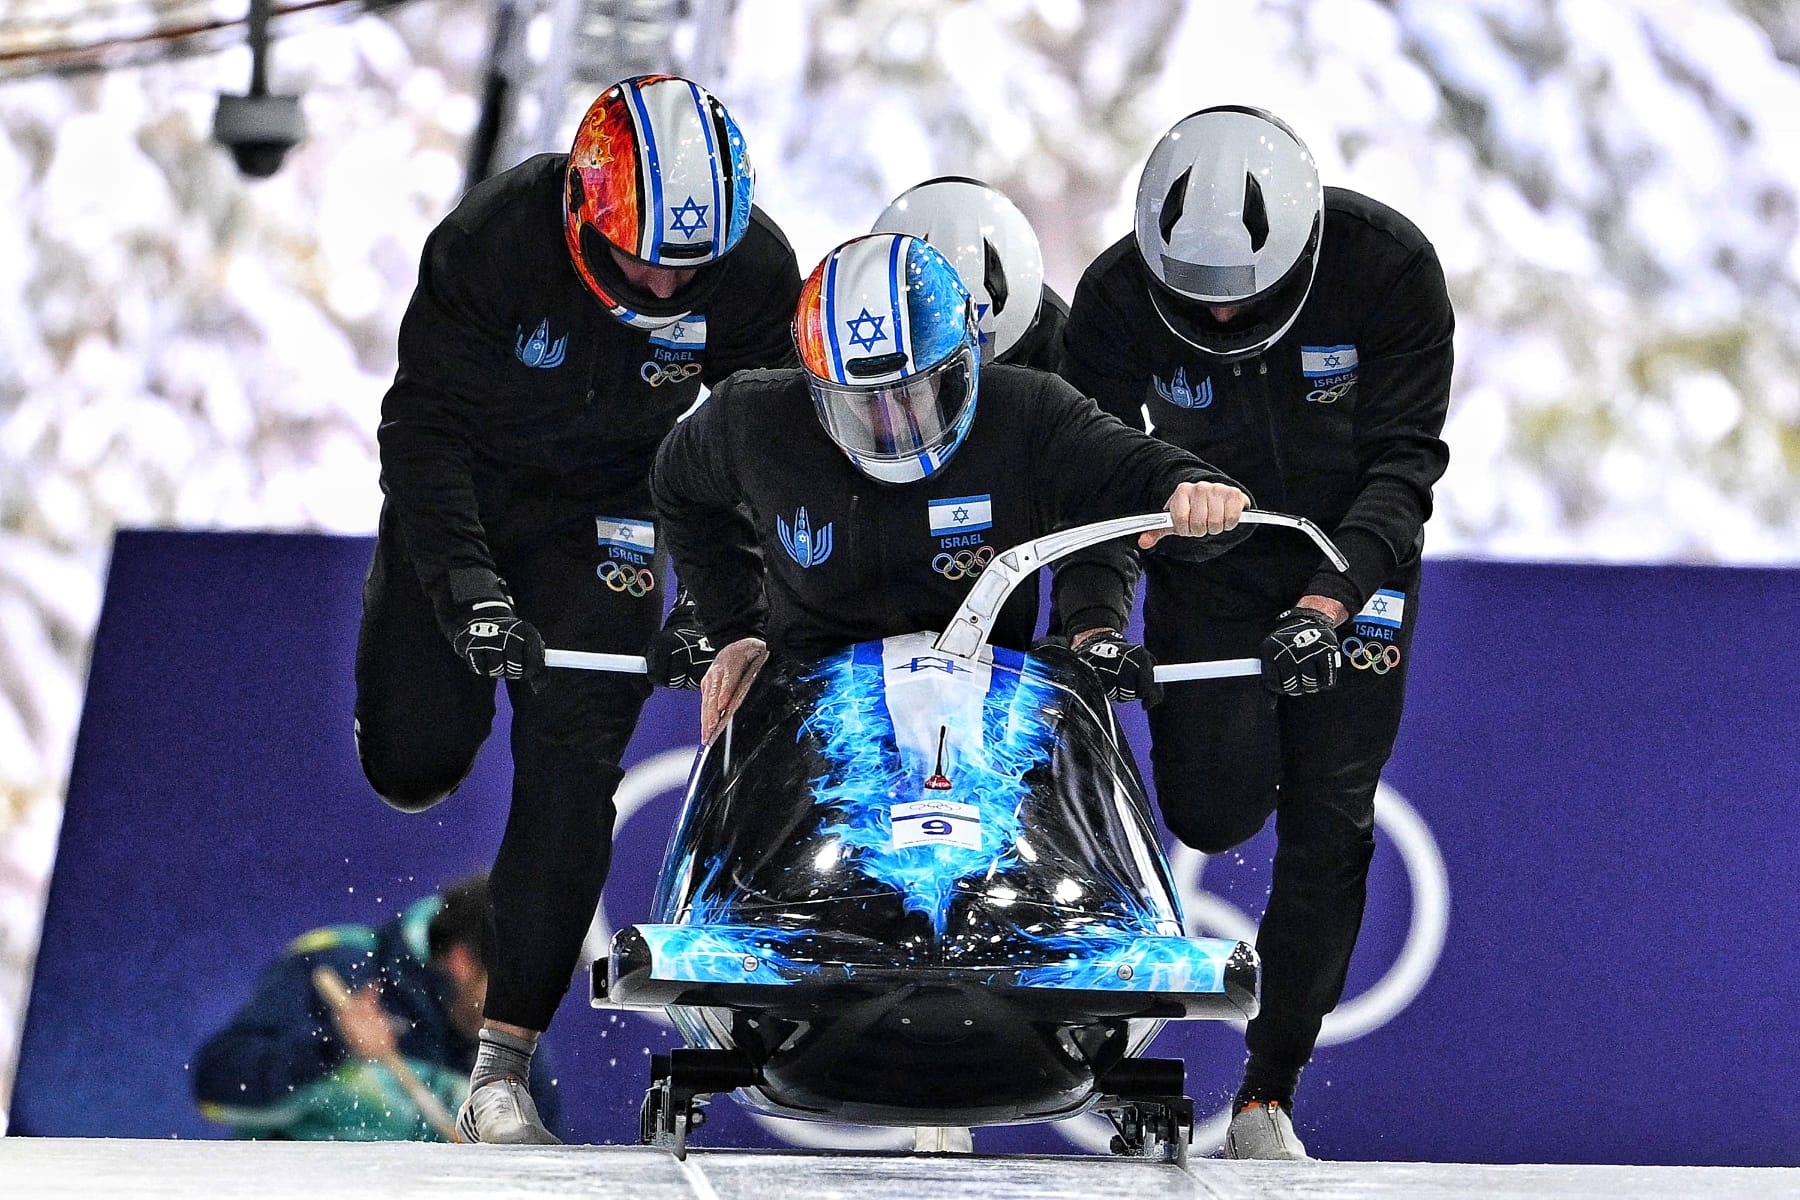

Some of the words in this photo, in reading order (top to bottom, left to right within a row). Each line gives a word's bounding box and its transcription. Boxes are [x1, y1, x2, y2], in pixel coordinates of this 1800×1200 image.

[654, 347, 695, 362] ISRAEL
[940, 533, 985, 549] ISRAEL
[608, 546, 648, 565] ISRAEL
[1355, 624, 1394, 641] ISRAEL
[921, 819, 953, 836] 9
